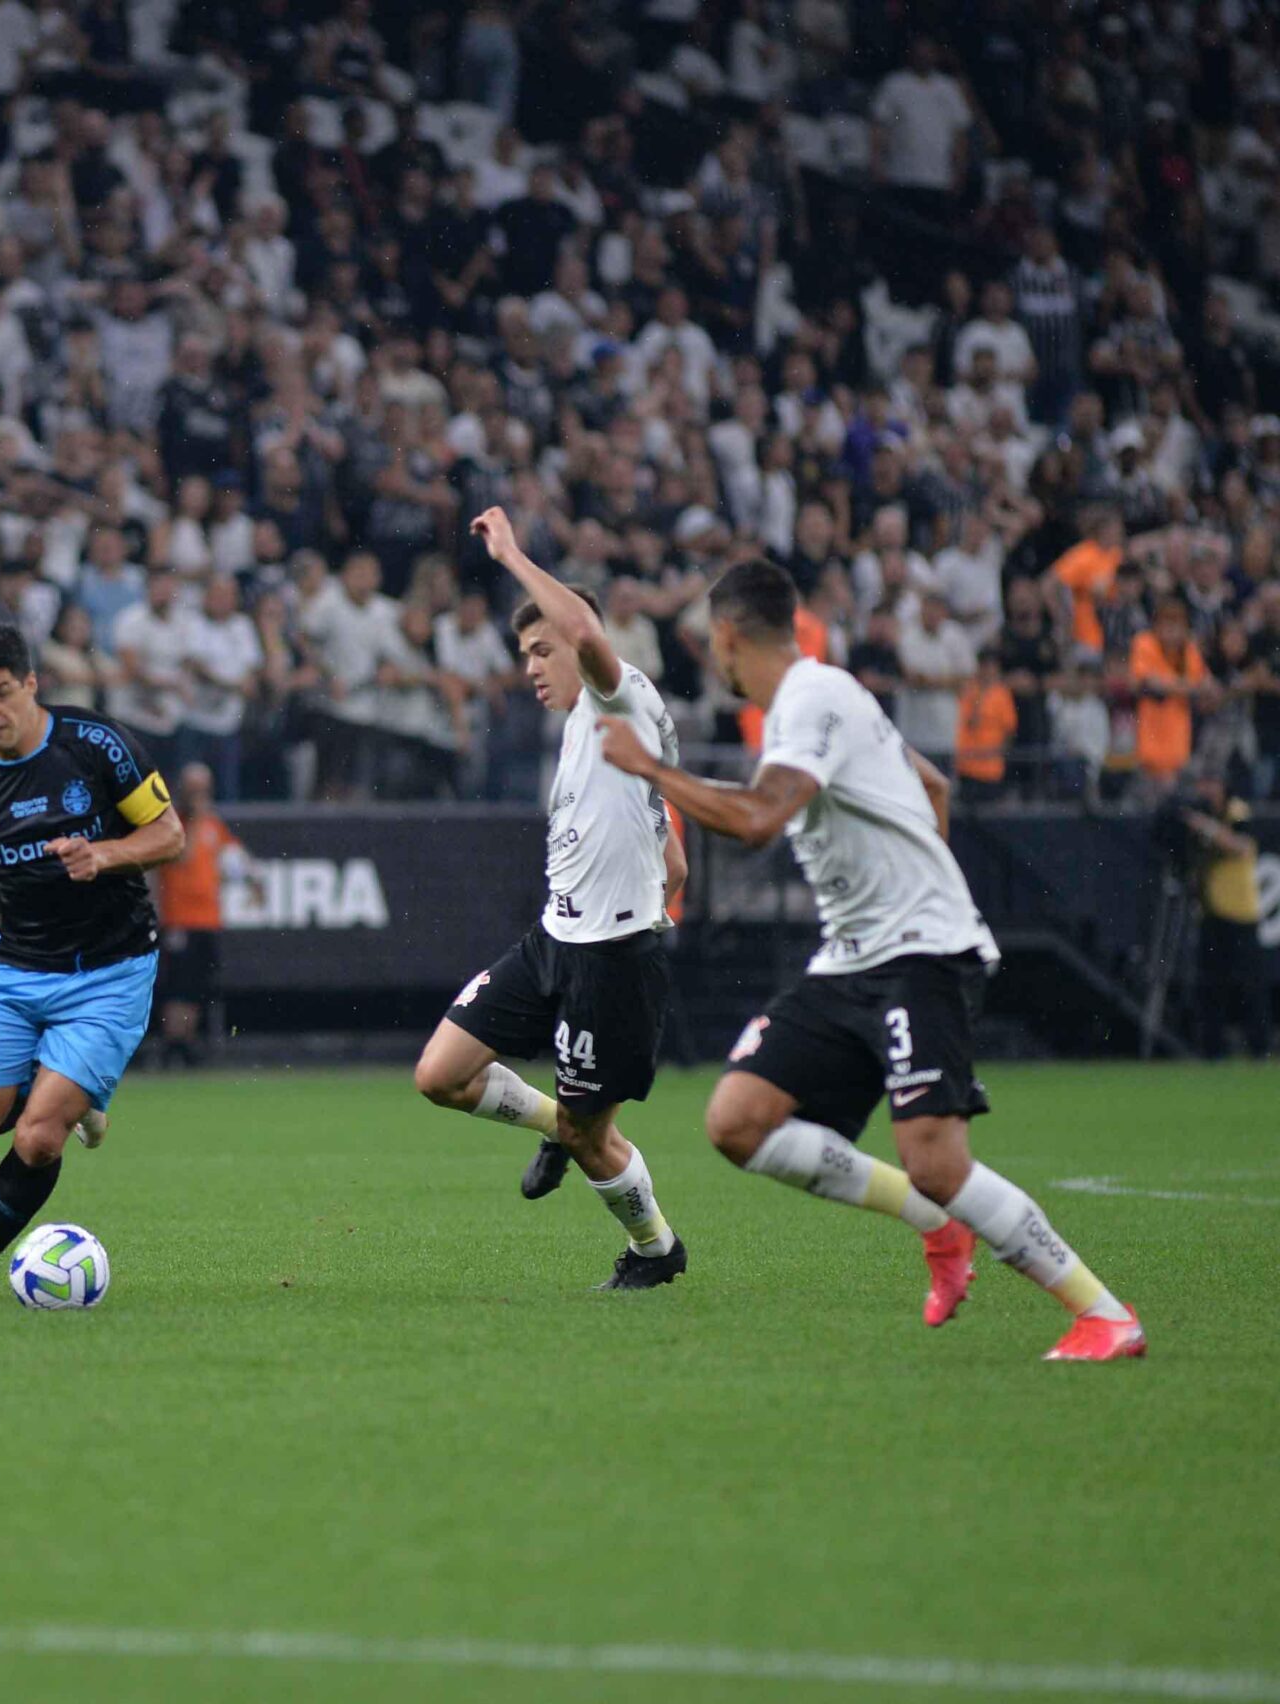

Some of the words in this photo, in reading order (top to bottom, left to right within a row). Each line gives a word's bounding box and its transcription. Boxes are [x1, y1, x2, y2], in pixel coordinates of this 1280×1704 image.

[77, 723, 124, 764] vero
[554, 1019, 596, 1070] 44
[884, 1006, 913, 1061] 3
